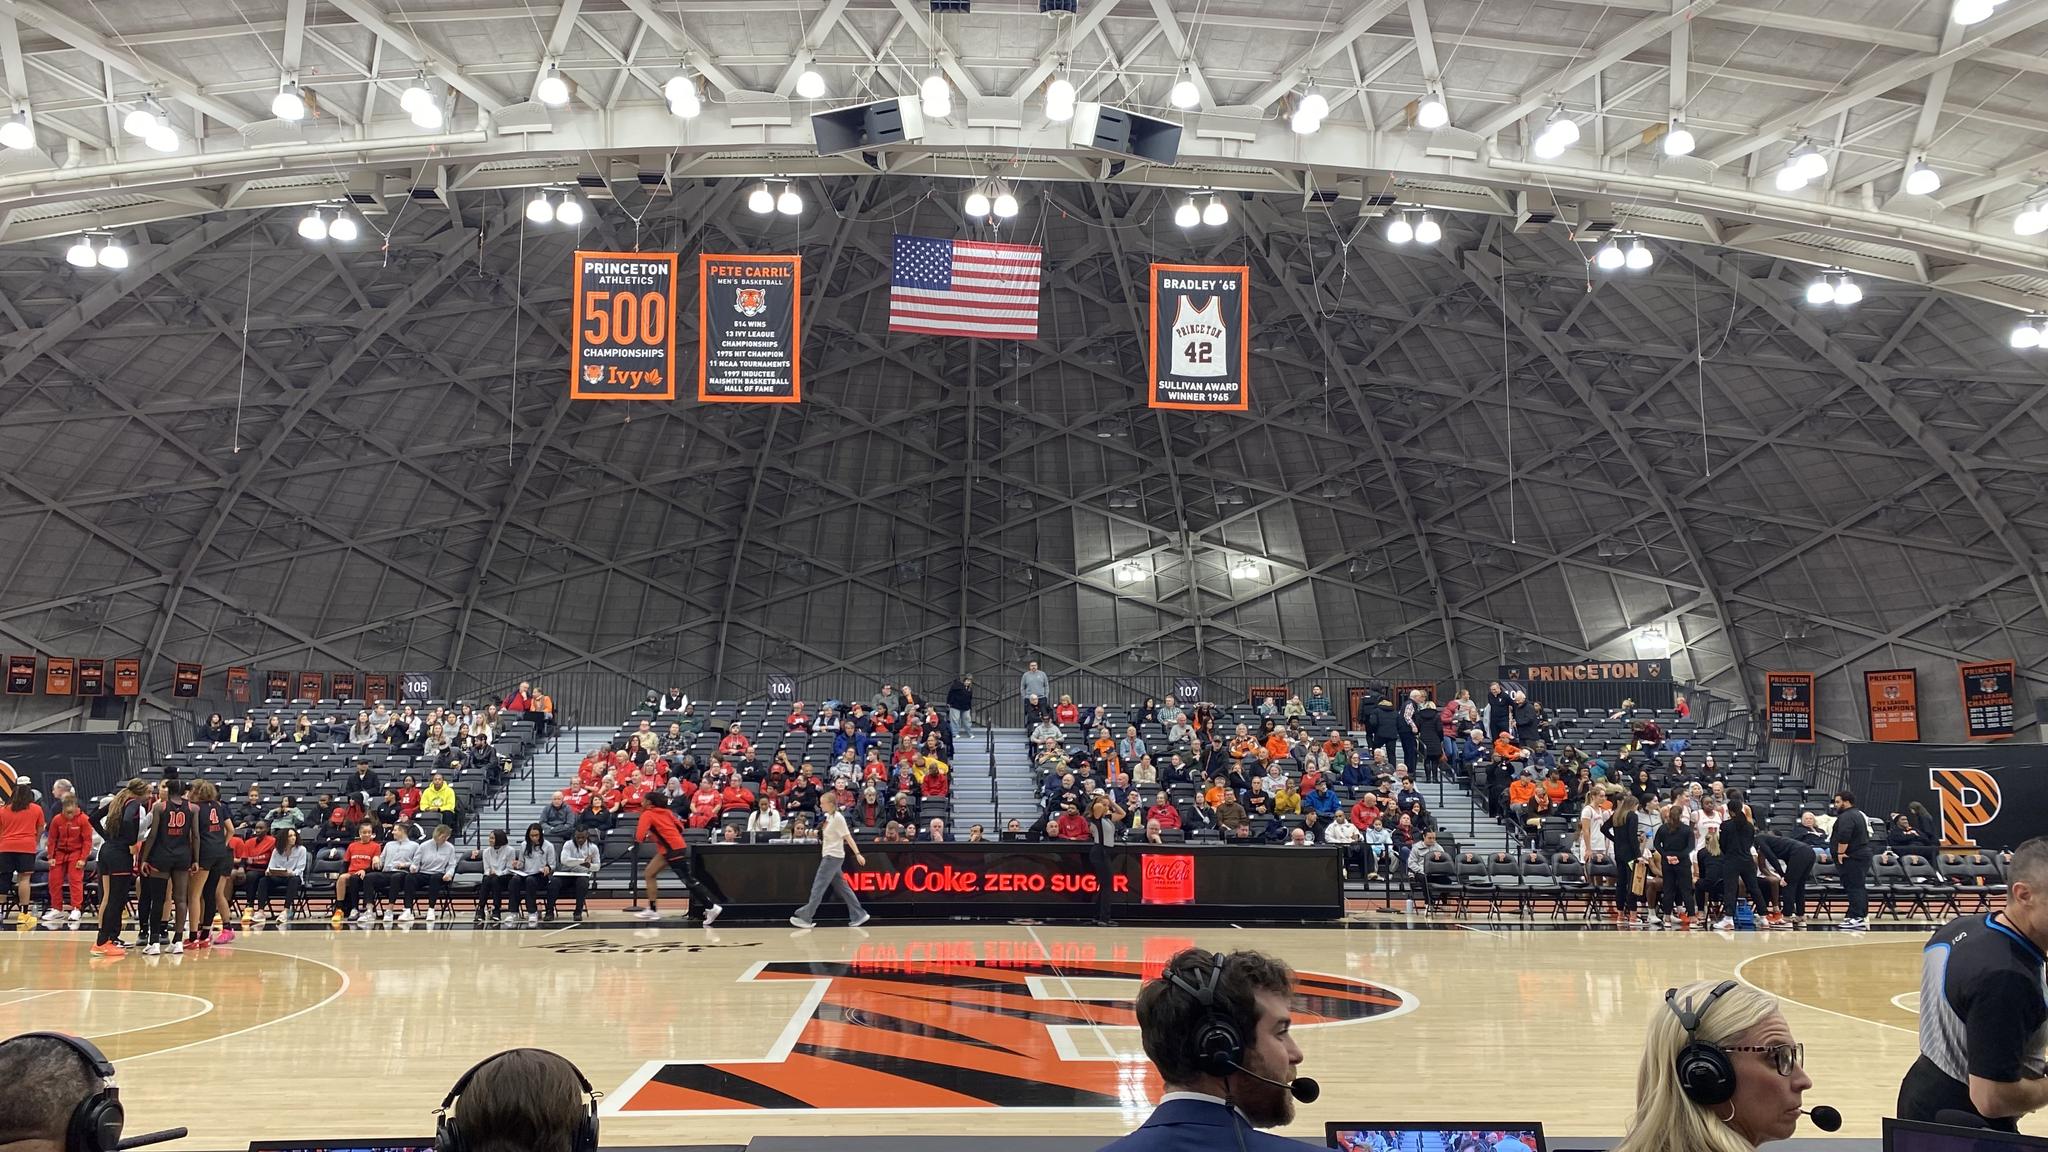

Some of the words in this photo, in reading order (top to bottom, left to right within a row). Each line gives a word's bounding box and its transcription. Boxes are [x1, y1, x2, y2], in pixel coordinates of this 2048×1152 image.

[584, 262, 668, 275] PRINCETON
[710, 265, 742, 277] PETE
[745, 267, 791, 277] CARRIL
[598, 276, 654, 285] ATHLETICS
[1163, 278, 1217, 290] BRADLEY
[1219, 279, 1236, 291] '65
[584, 291, 666, 345] 500
[1175, 324, 1223, 339] PRINCETON
[721, 340, 779, 348] CHAMPIONSHIPS
[583, 348, 665, 358] CHAMPIONSHIPS
[1184, 341, 1213, 364] 42
[739, 360, 791, 368] TOURNAMENTS
[607, 366, 644, 389] Ivy
[754, 385, 774, 393] FAME
[1158, 380, 1204, 391] SULLIVAN
[1204, 381, 1239, 391] AWARD
[1168, 391, 1206, 402] WINNER
[1207, 392, 1230, 402] 1965
[1528, 662, 1639, 681] PRINCETON
[407, 681, 428, 692] 105
[771, 683, 791, 694] 106
[1179, 686, 1199, 697] 107
[1929, 768, 2002, 846] P
[167, 811, 186, 827] 10
[209, 807, 220, 824] 4
[1145, 859, 1191, 880] Coca-Cola
[843, 872, 900, 891] NEW
[983, 873, 1046, 892] ZERO
[1050, 874, 1129, 892] SUGR
